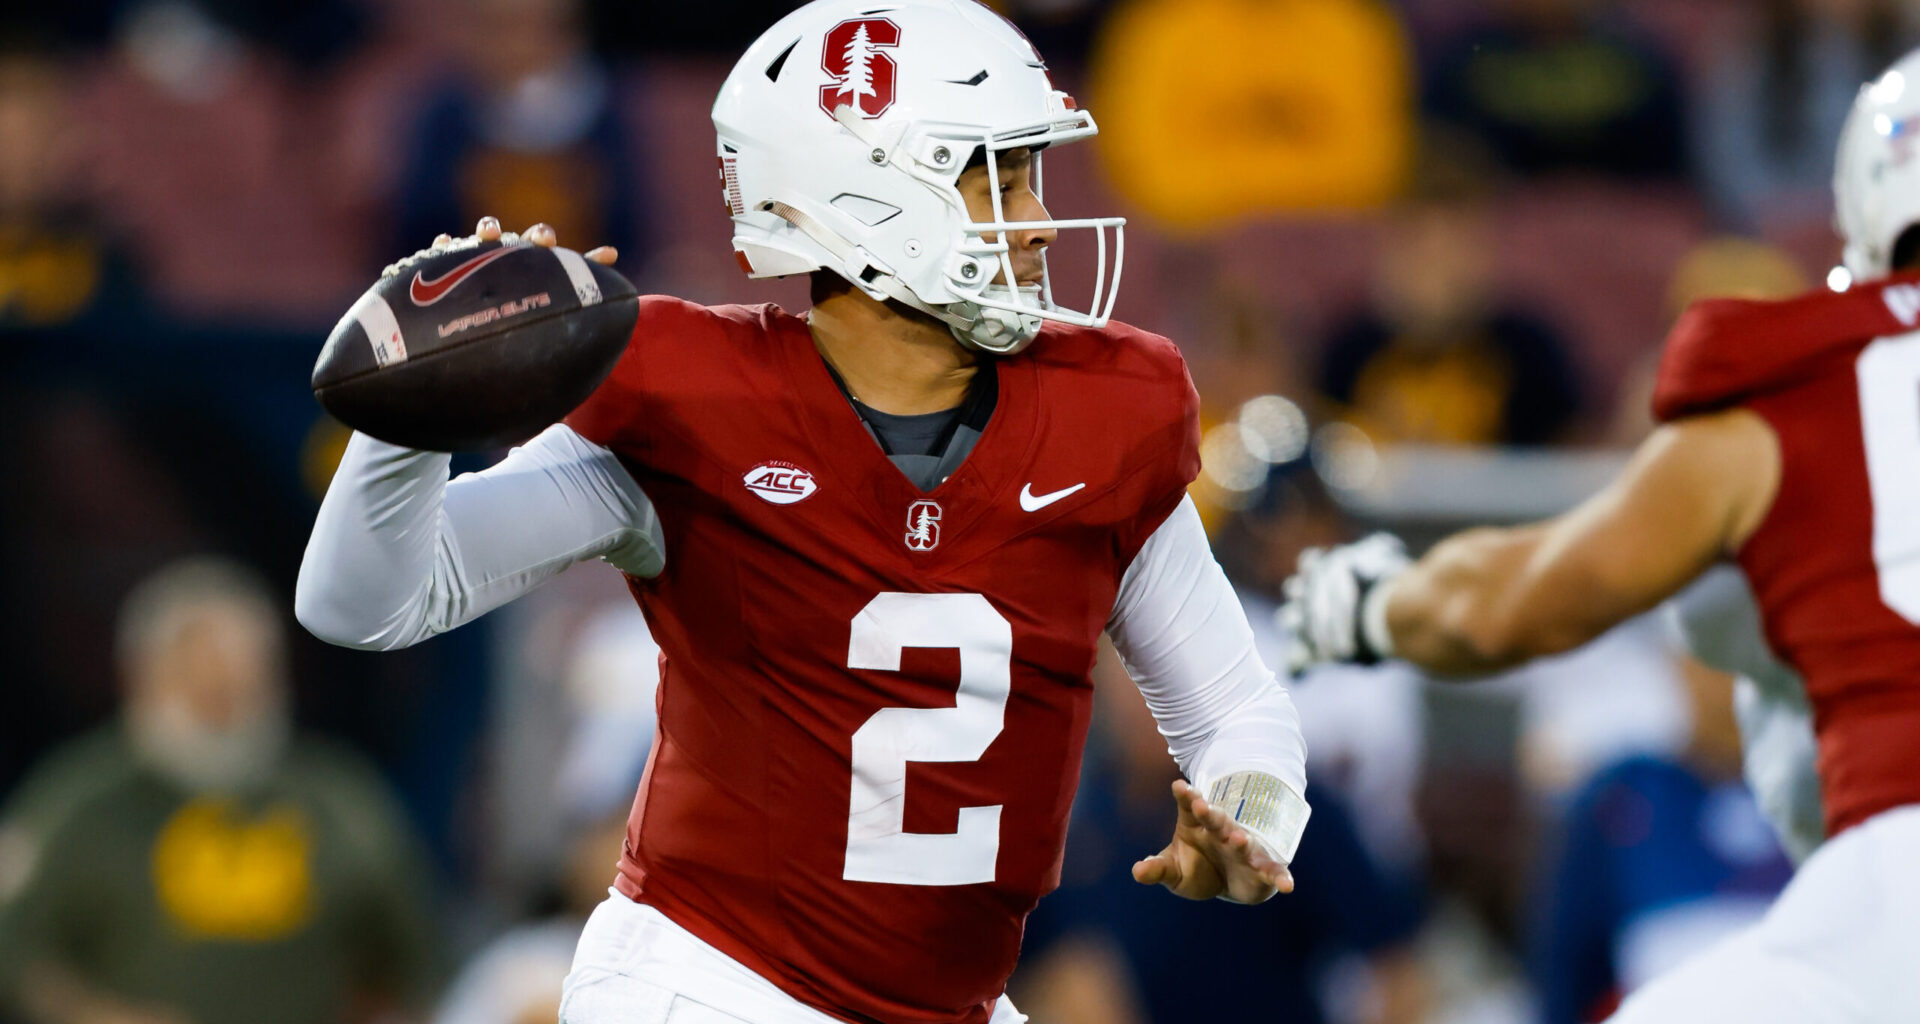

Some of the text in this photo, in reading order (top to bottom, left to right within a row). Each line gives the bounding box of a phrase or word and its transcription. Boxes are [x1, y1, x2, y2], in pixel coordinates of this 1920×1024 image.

[819, 17, 902, 121] S
[501, 292, 551, 318] ELITE
[752, 472, 810, 490] ACC
[843, 592, 1012, 886] 2
